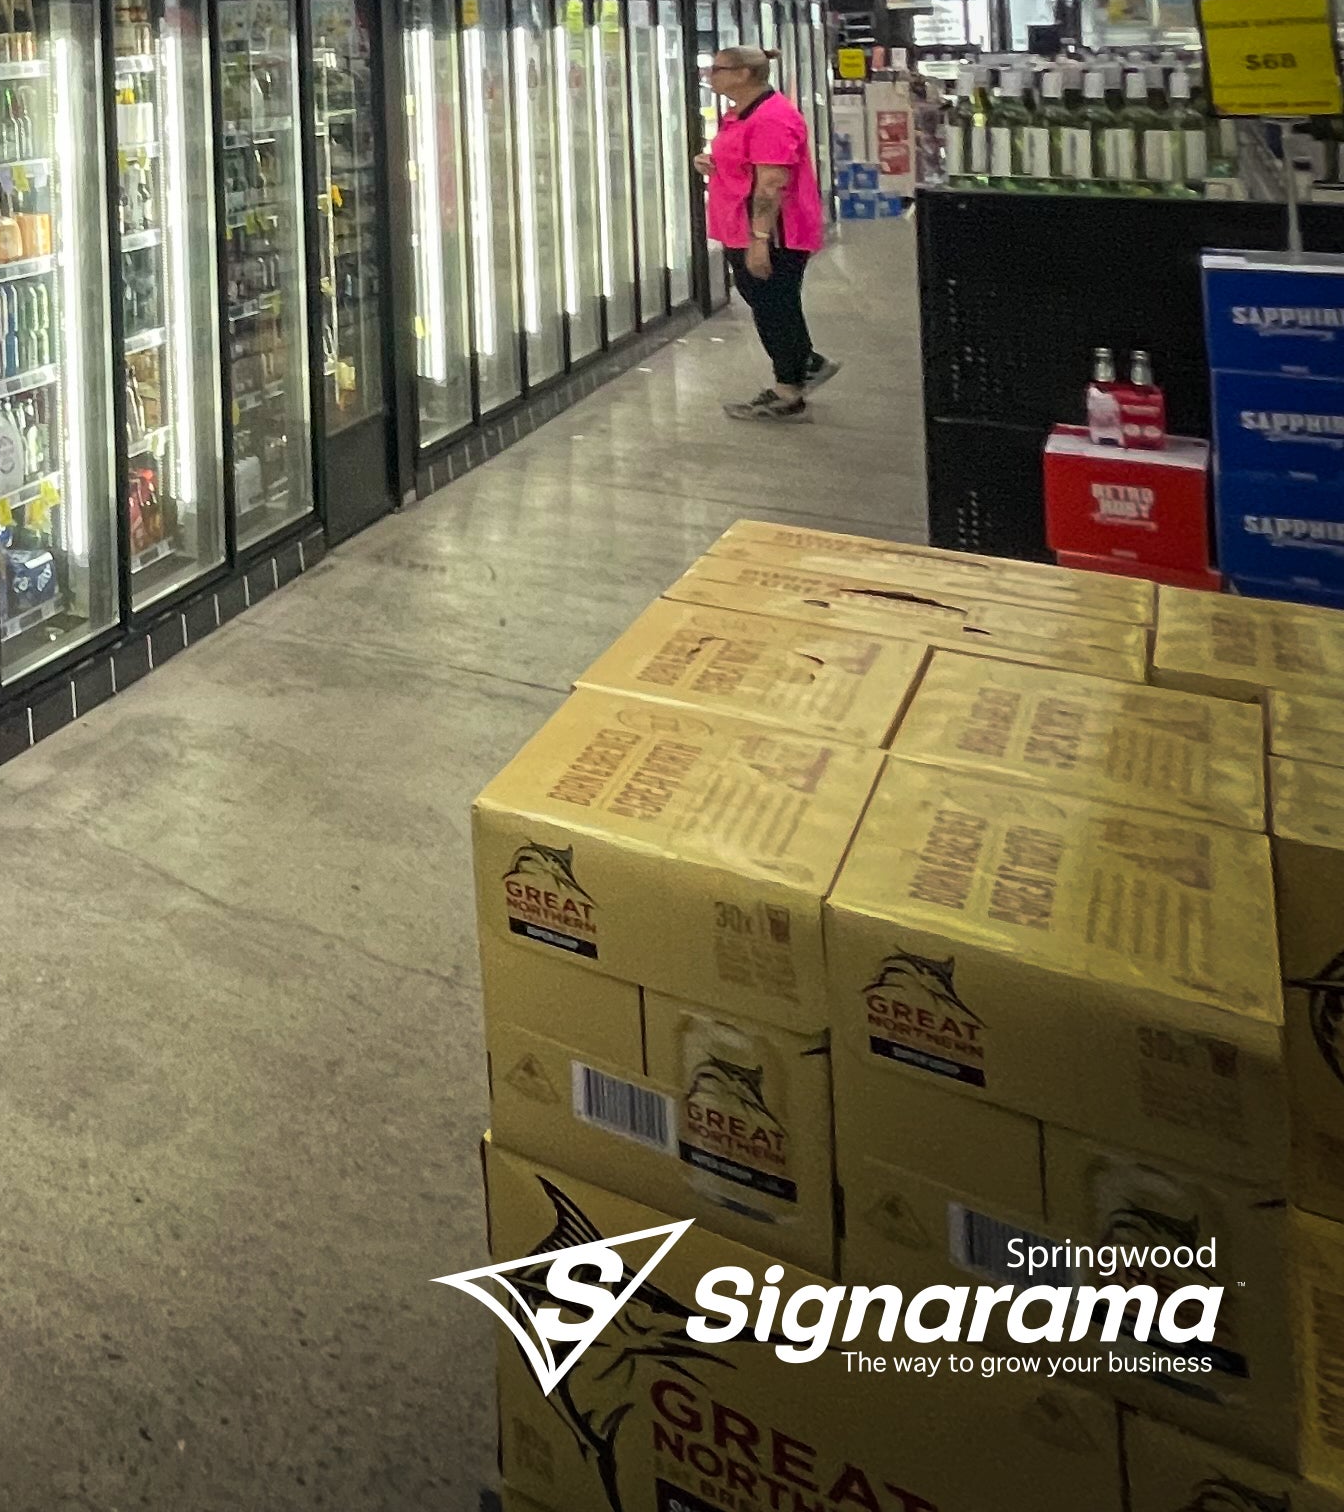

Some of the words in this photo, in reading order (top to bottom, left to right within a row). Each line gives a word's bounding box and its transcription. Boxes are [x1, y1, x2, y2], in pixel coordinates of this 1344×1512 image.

[1232, 306, 1344, 328] SAPPHIR
[505, 880, 596, 920] GREAT
[506, 896, 597, 934] NORTHERN
[866, 993, 983, 1043] GREAT
[866, 1012, 984, 1060] NORTHERN
[687, 1101, 786, 1152] GREAT
